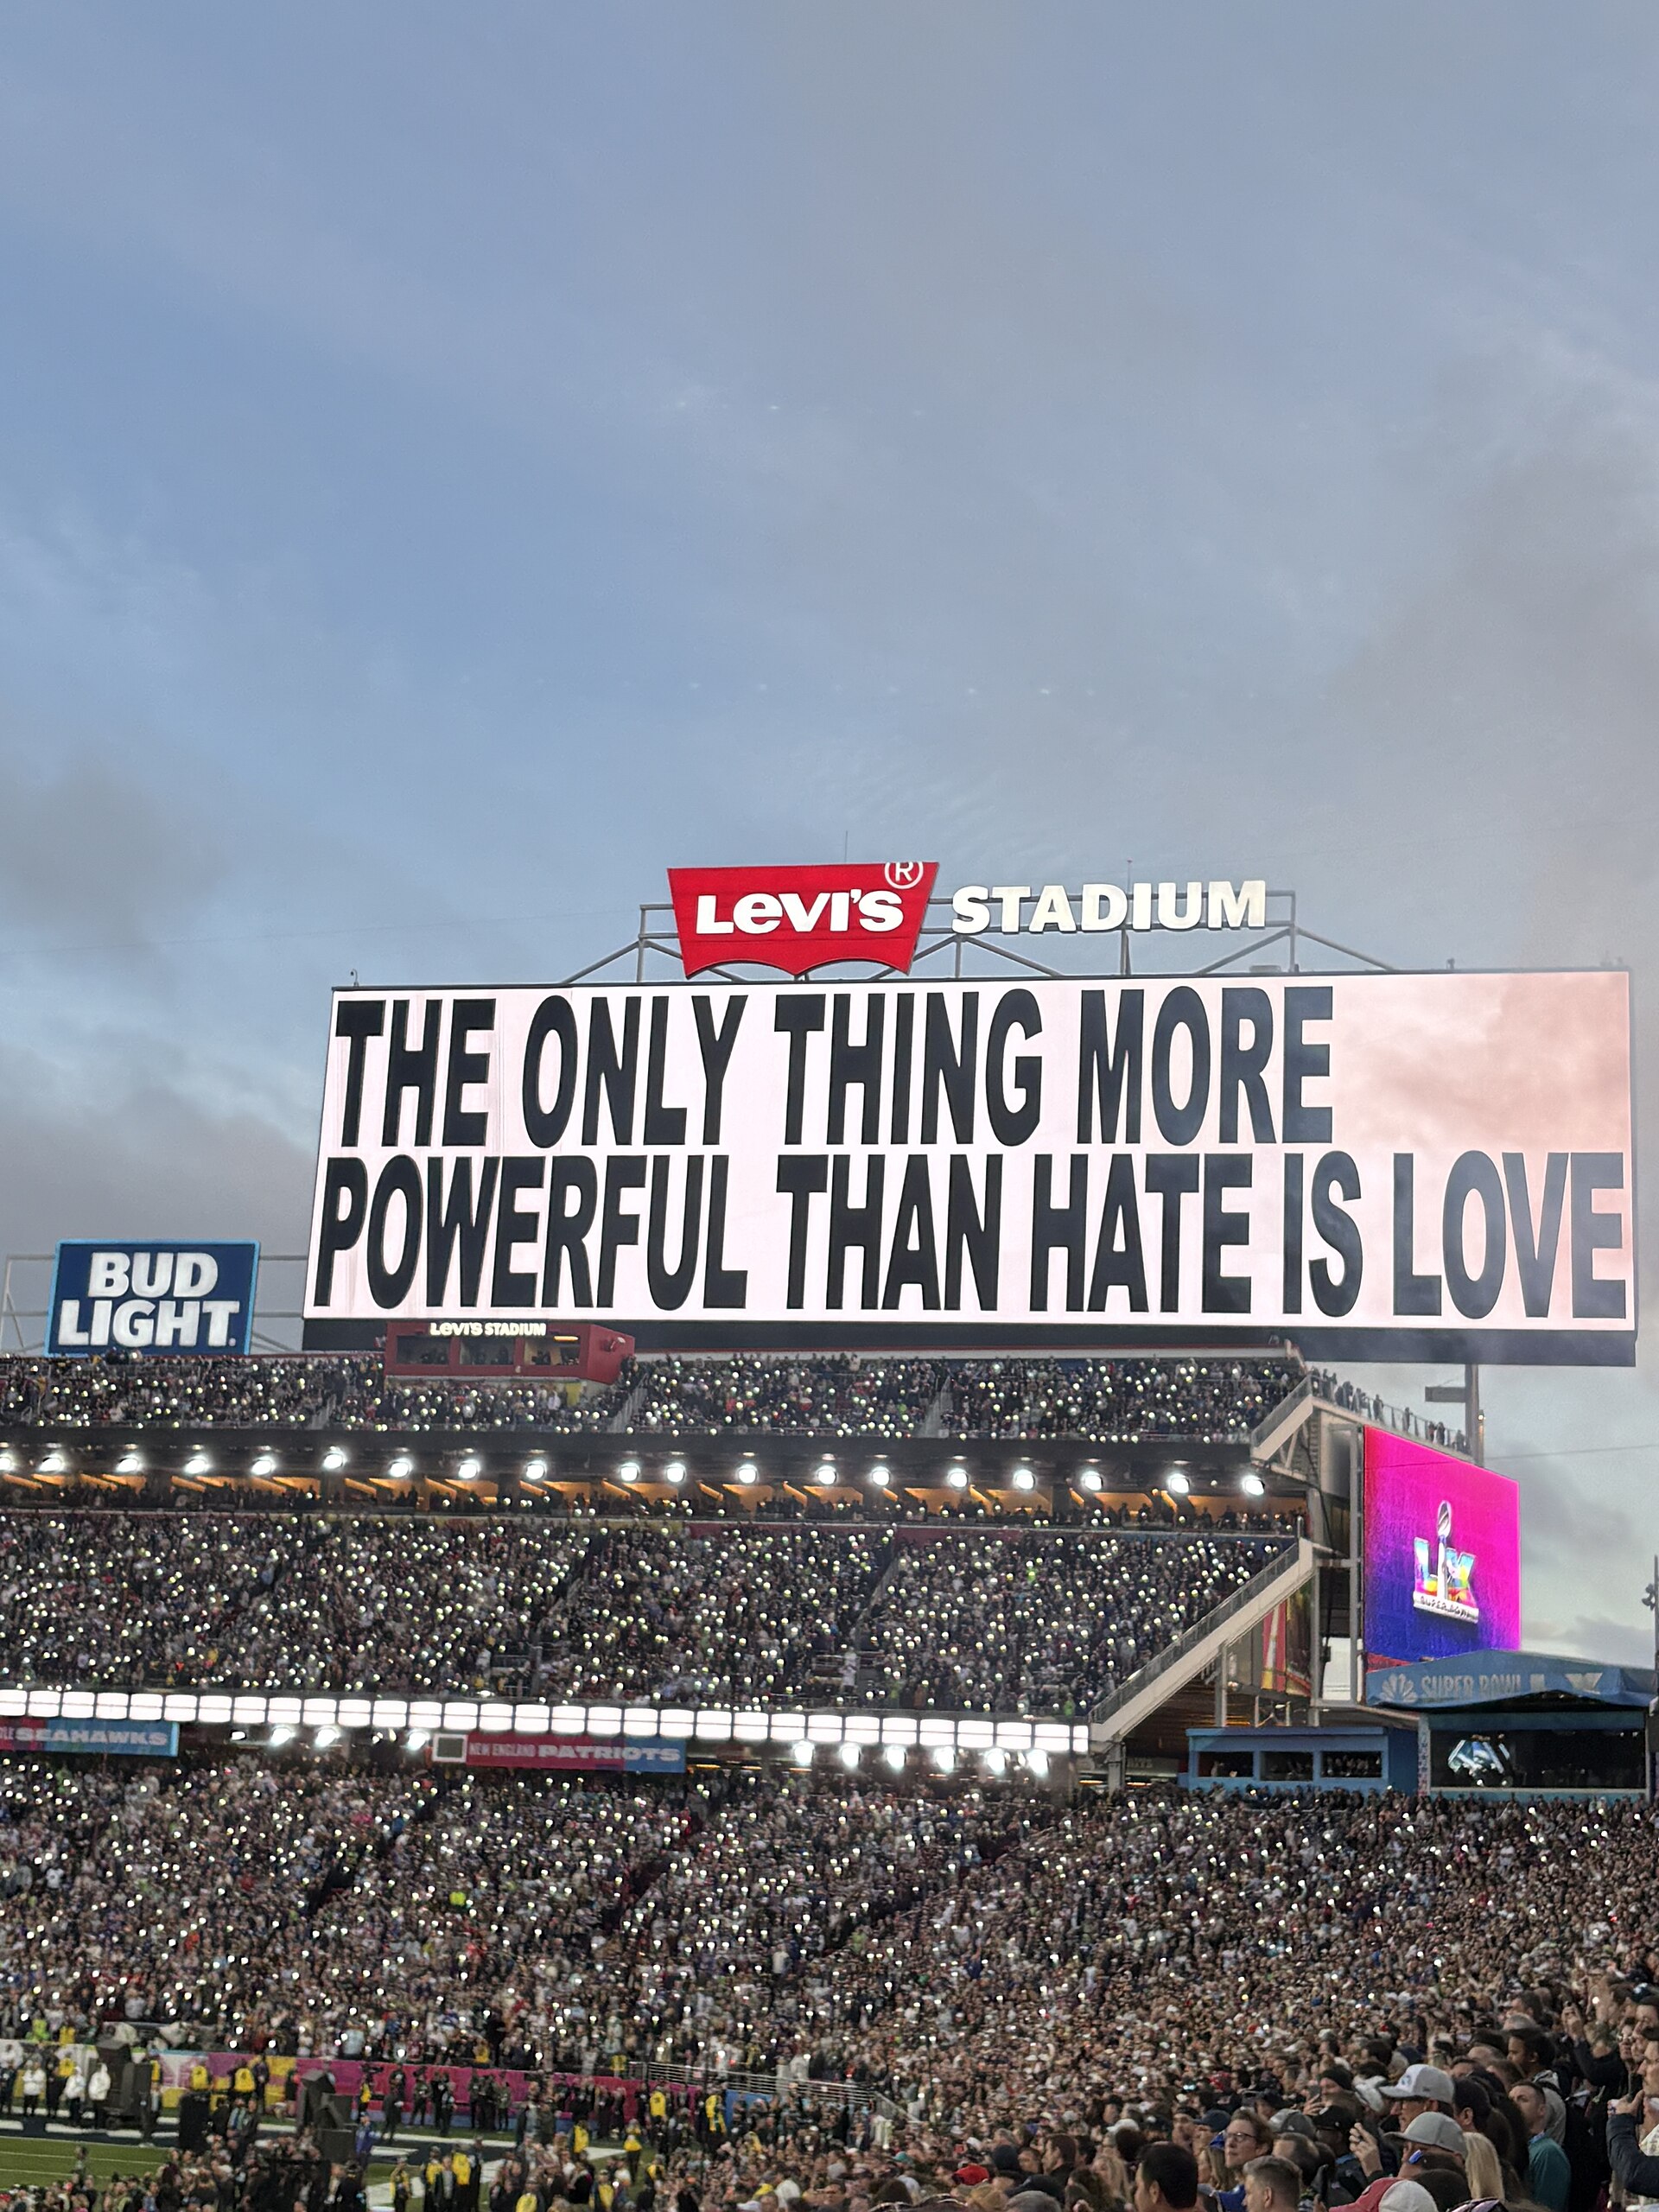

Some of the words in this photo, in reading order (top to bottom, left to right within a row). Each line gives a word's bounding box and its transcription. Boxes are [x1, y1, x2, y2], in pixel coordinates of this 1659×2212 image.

[951, 880, 1267, 934] STADIUM
[335, 998, 497, 1147] THE
[522, 995, 749, 1148] ONLY
[774, 988, 1043, 1147] THING
[1077, 986, 1333, 1146] MORE
[313, 1154, 748, 1310] POWERFUL
[777, 1154, 1003, 1312] THAN
[1029, 1154, 1253, 1314] HATE
[1282, 1150, 1363, 1318] IS
[1392, 1150, 1627, 1319] LOVE
[88, 1252, 219, 1298] BUD
[485, 1323, 546, 1336] STADIUM
[1421, 1675, 1473, 1700] SUPER
[15, 1727, 168, 1745] SEAHAWKS
[468, 1742, 490, 1757] NEW
[492, 1743, 536, 1757] ENGLAND
[538, 1745, 680, 1761] PATRIOTS
